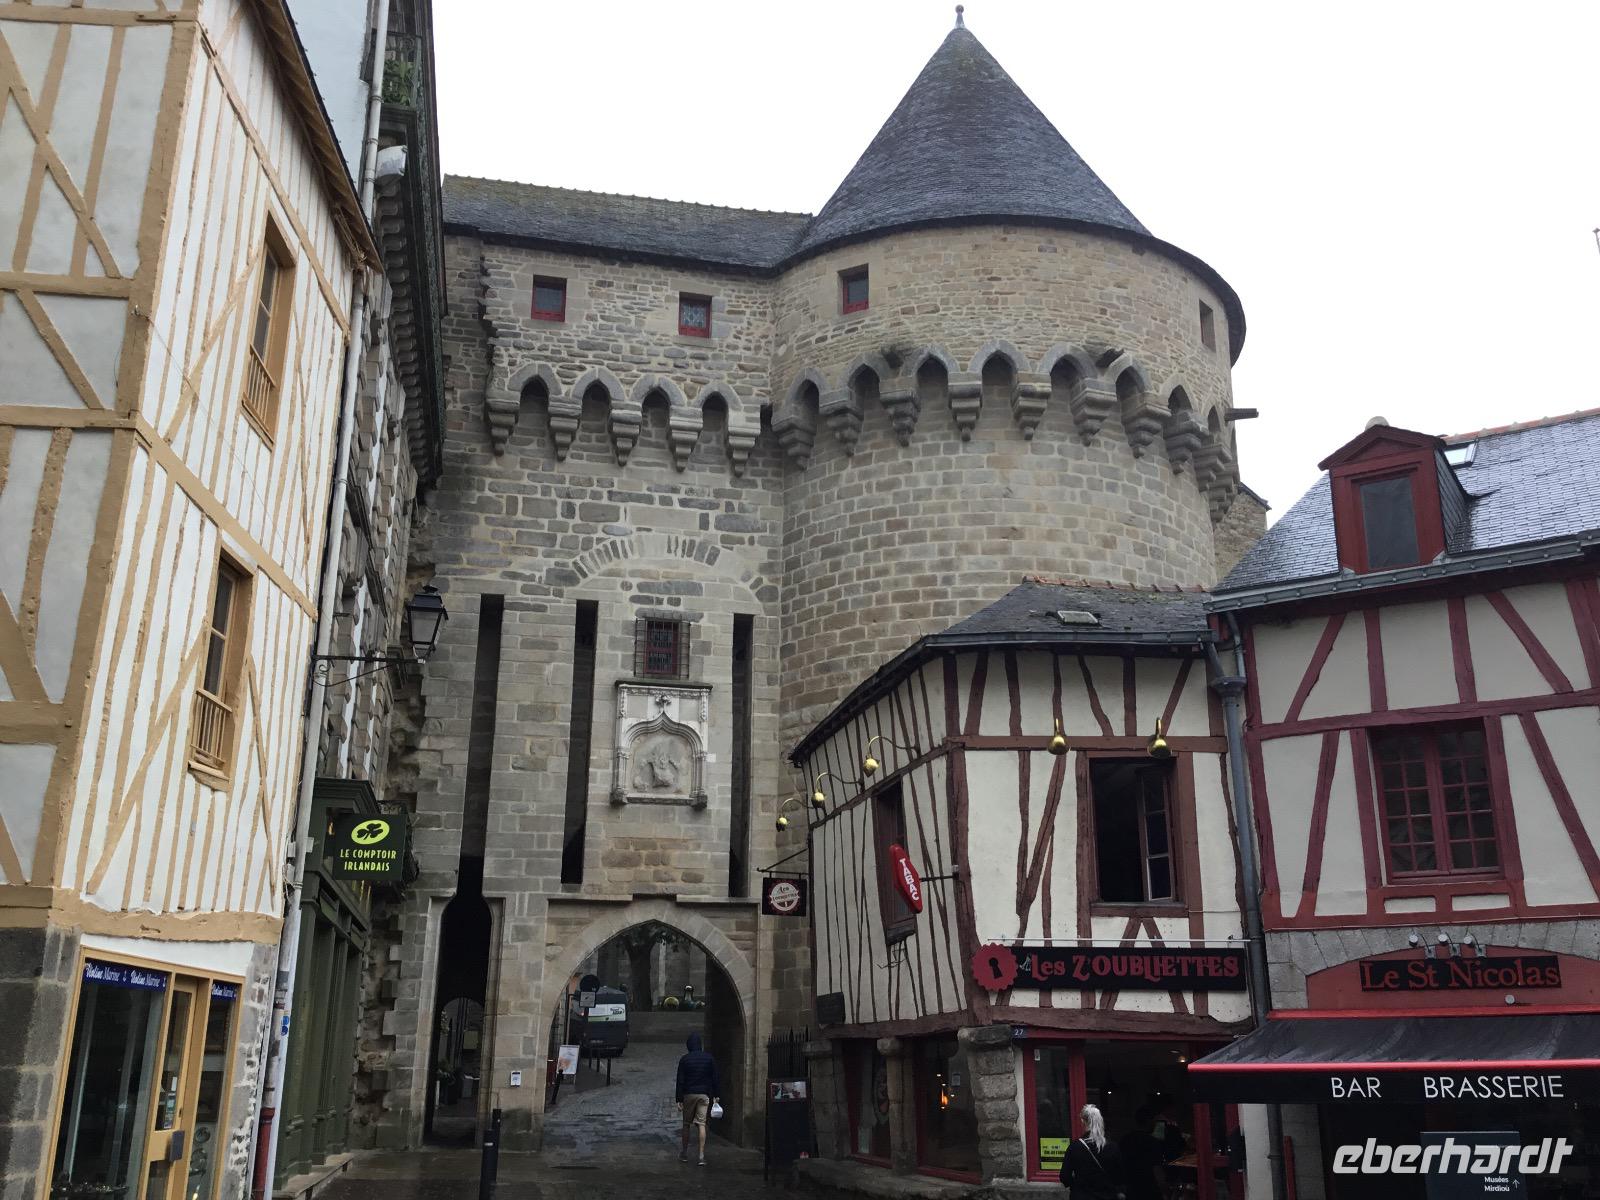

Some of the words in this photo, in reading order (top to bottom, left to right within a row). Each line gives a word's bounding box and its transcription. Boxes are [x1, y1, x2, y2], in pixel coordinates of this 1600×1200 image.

[340, 848, 350, 858] LE
[352, 849, 397, 859] COMPTOIR
[344, 861, 390, 871] IRLANDAIS
[899, 858, 919, 901] TABAC
[1030, 954, 1066, 981] Les
[1362, 962, 1400, 989] Le
[1407, 960, 1440, 989] St
[1446, 958, 1561, 988] Nicolas
[1331, 1077, 1382, 1098] BAR
[1423, 1075, 1565, 1099] BRASSERIE
